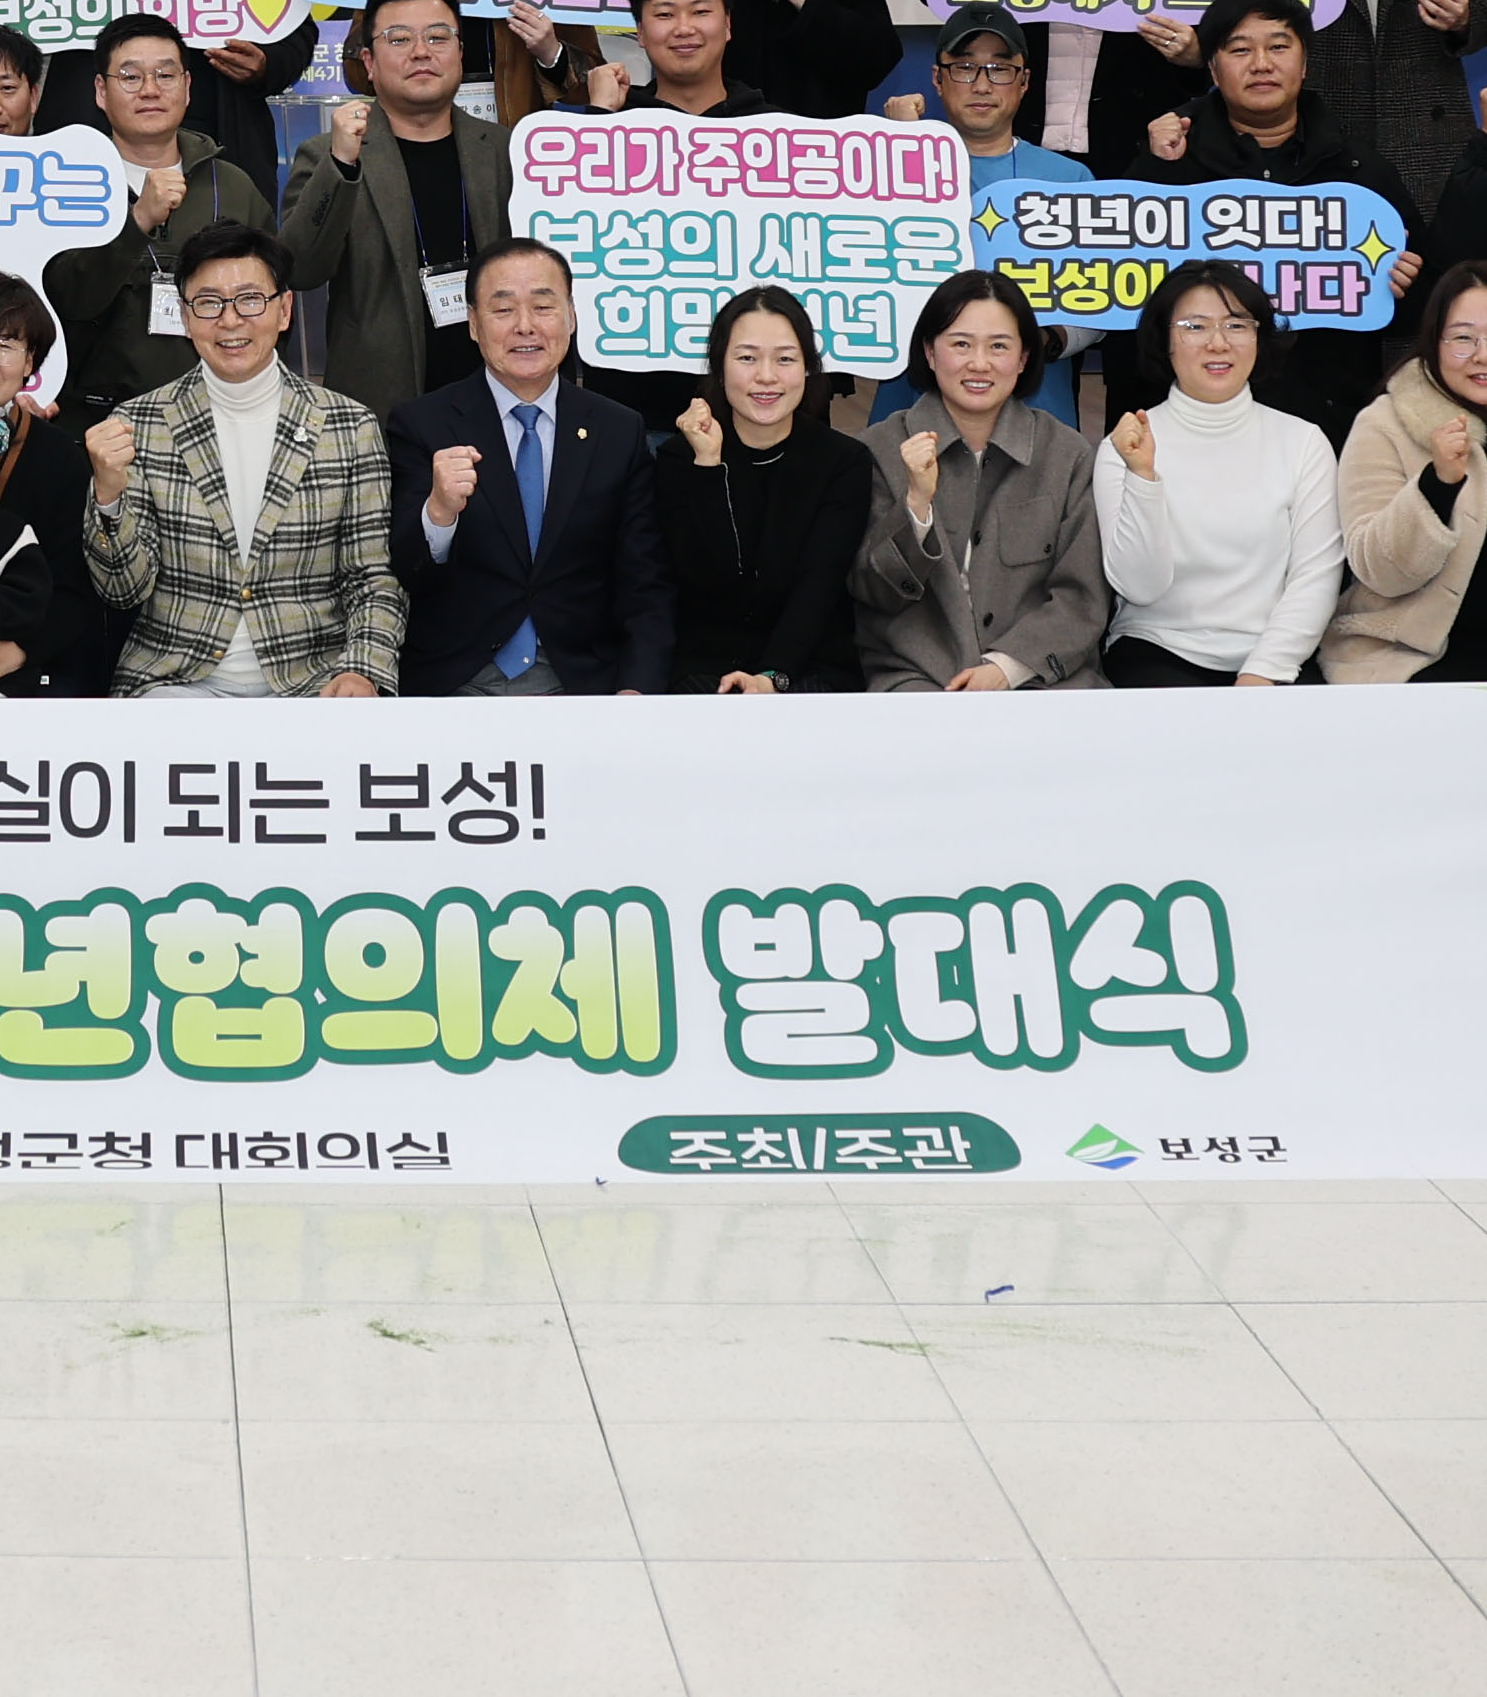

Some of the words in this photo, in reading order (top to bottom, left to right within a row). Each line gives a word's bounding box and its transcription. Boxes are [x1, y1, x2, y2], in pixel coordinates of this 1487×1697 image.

[524, 125, 684, 197] 우리가
[687, 127, 959, 202] 주인공이다!
[530, 209, 738, 282] 보성의
[751, 211, 964, 286] 새로운
[1014, 191, 1188, 251] 청년이
[1202, 194, 1347, 251] 잇다!
[797, 288, 899, 363] 년
[162, 760, 331, 845] 되는
[354, 760, 547, 846] 보성!
[702, 880, 1248, 1080] 발대식
[173, 1130, 453, 1172] 대회의실
[668, 1125, 973, 1172] 주최/주관
[1157, 1134, 1289, 1164] 보성군
